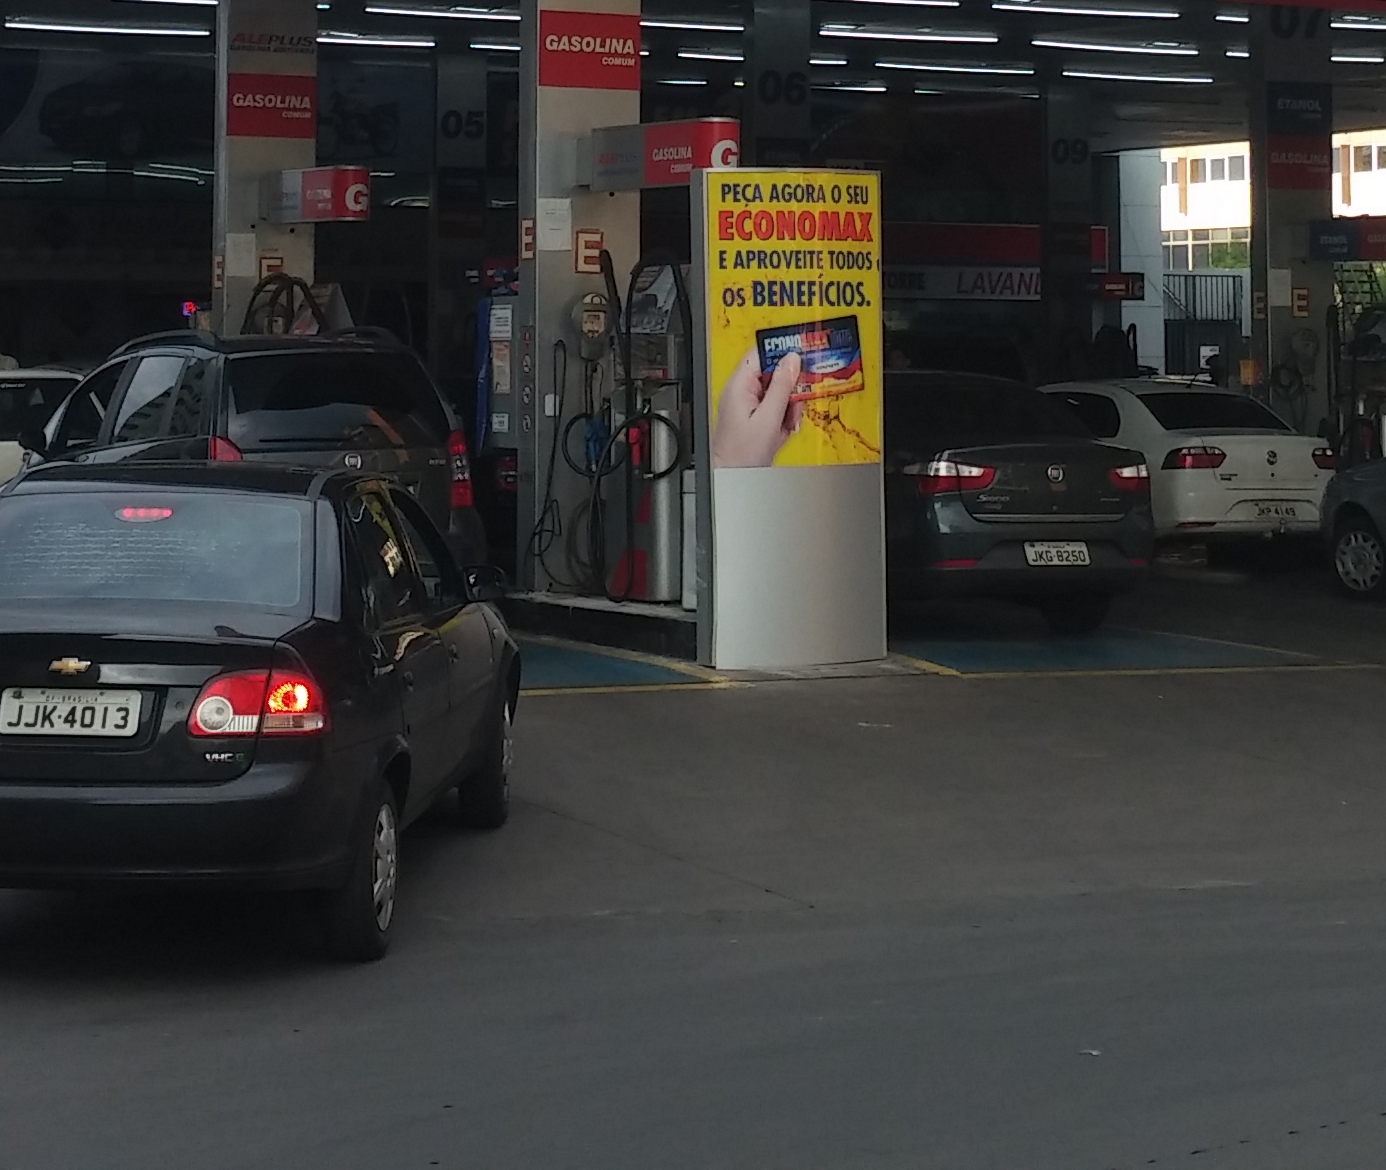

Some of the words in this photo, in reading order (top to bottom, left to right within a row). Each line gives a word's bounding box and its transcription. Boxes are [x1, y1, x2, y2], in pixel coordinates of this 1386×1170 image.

[232, 33, 315, 46] ALEPLUS
[545, 34, 635, 54] GASOLINA
[602, 56, 635, 67] COMUM
[233, 93, 311, 109] GASOLINA
[757, 71, 807, 105] 06
[442, 109, 484, 139] 05
[652, 145, 692, 162] GASOLINA
[711, 139, 738, 167] G
[1050, 138, 1088, 165] 09
[344, 183, 368, 212] G
[721, 183, 763, 207] PEÇA
[769, 184, 826, 203] AGORA
[831, 184, 842, 203] O
[847, 185, 869, 204] SEU
[718, 210, 873, 242] ECONOMAX
[577, 231, 603, 272] E
[718, 250, 728, 270] E
[733, 250, 824, 270] APROVEITE
[828, 250, 872, 271] TODOS
[752, 273, 871, 307] BENEFÍCIOS.
[1292, 288, 1308, 317] E
[1032, 549, 1086, 563] JKG-8250
[7, 705, 129, 730] JJK-4013
